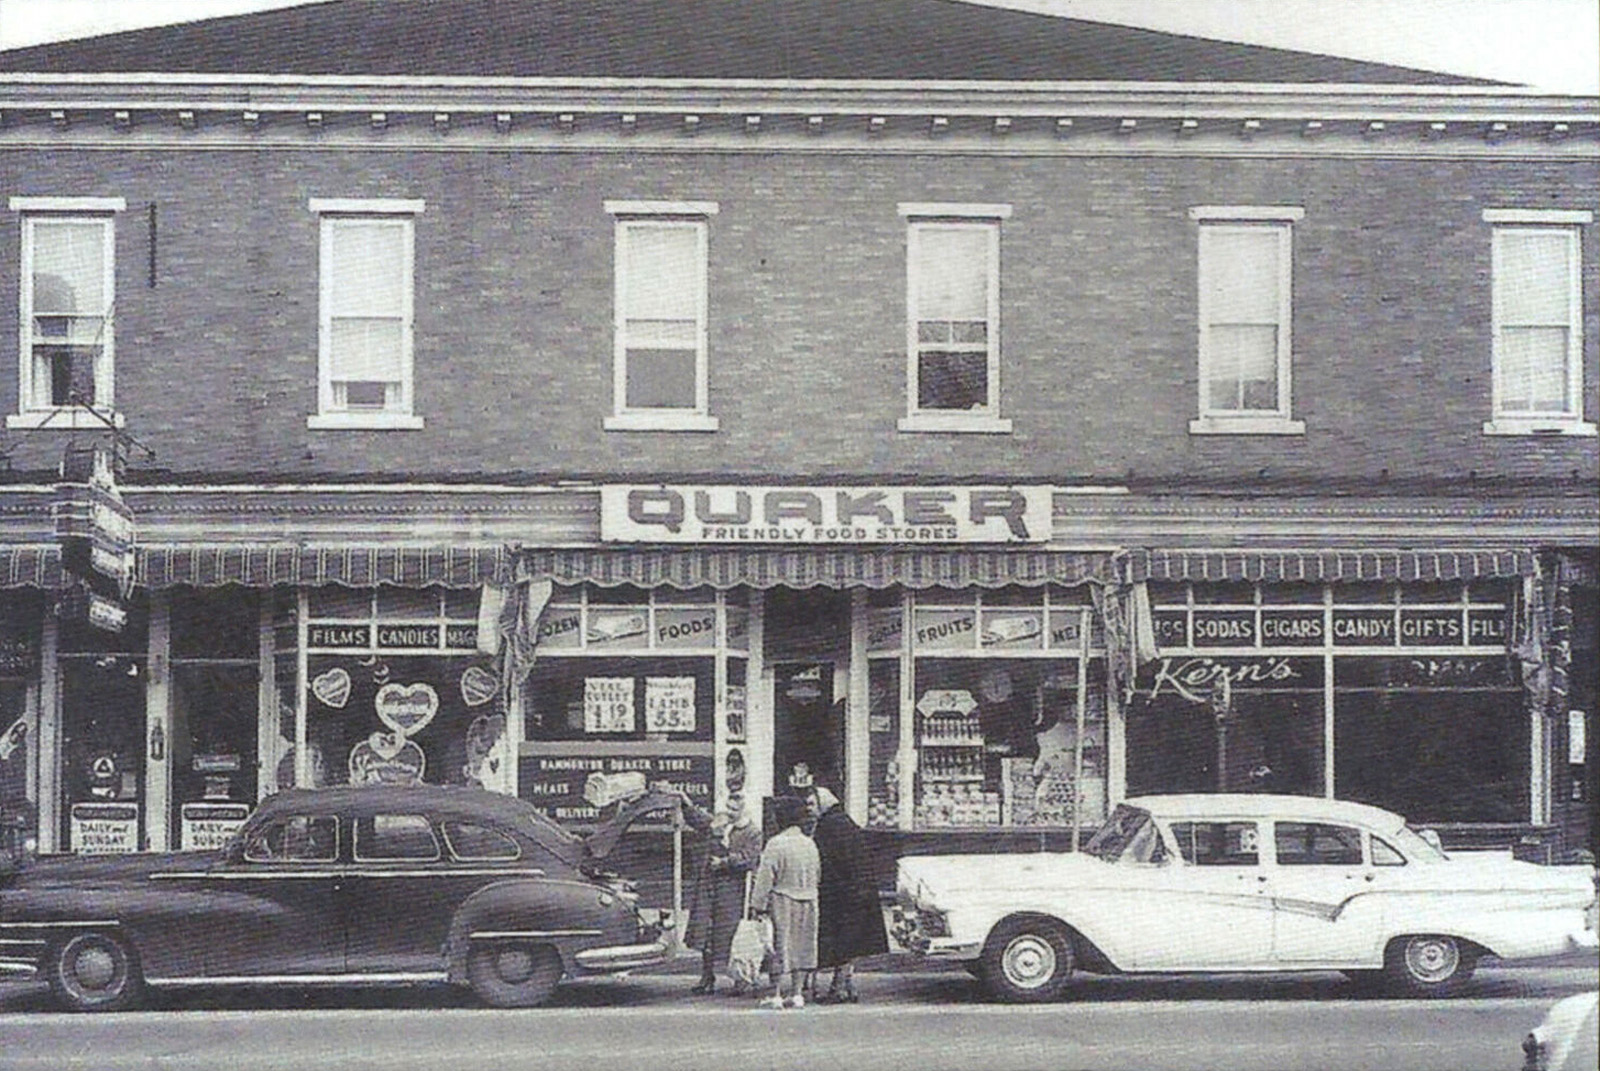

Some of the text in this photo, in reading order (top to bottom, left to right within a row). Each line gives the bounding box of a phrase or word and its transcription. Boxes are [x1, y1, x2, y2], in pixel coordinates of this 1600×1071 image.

[627, 489, 1031, 538] QUAKER
[702, 527, 959, 540] FRIENDLY FOOD STORES
[312, 629, 366, 645] FILMS
[379, 629, 438, 645] CANDIES
[541, 616, 580, 637] OZEN
[658, 618, 712, 642] FOODS
[917, 618, 973, 643] FRUITS
[1195, 619, 1252, 638] SODAS
[1263, 619, 1322, 638] CIGARS
[1334, 619, 1392, 637] CANDY
[1402, 619, 1460, 637] GIFTS
